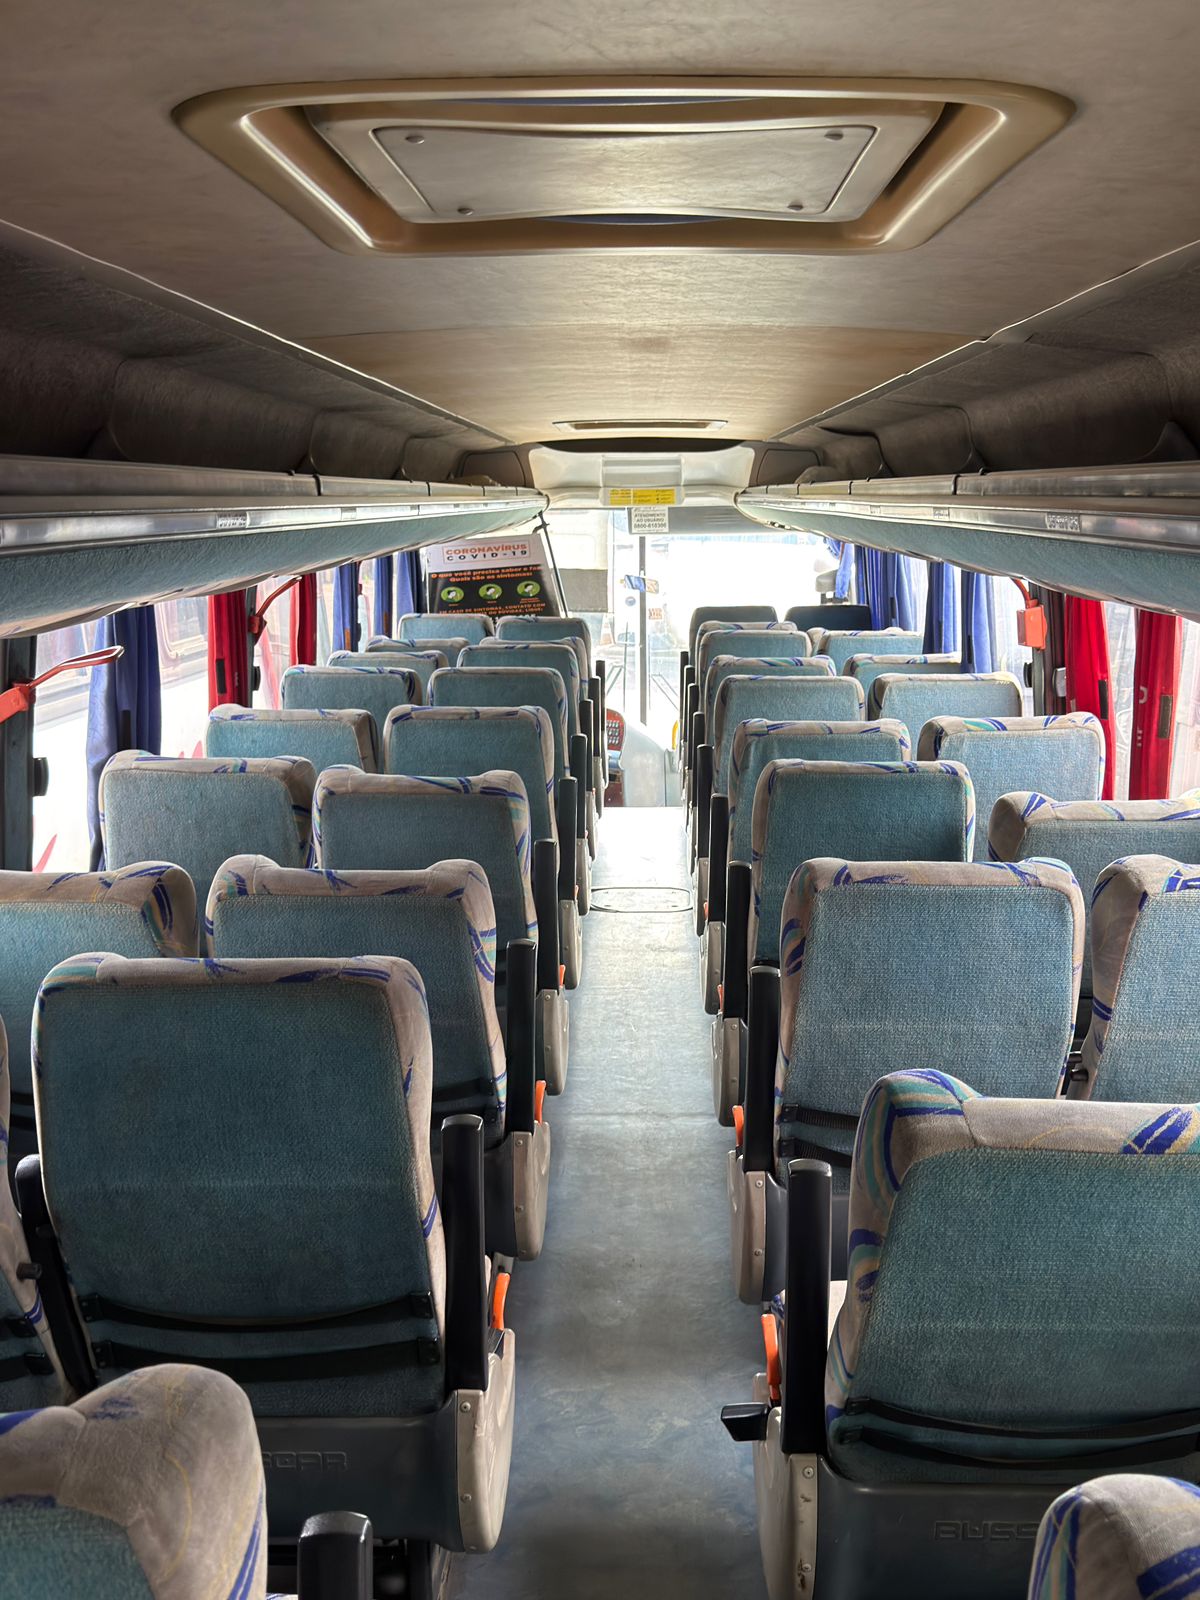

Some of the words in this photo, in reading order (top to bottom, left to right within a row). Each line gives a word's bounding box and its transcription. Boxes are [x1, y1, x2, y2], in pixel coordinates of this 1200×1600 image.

[445, 544, 528, 556] CORONAVÍRUS
[446, 550, 528, 561] COVID-19
[473, 569, 500, 577] precisa
[934, 1520, 1040, 1540] BUSS
